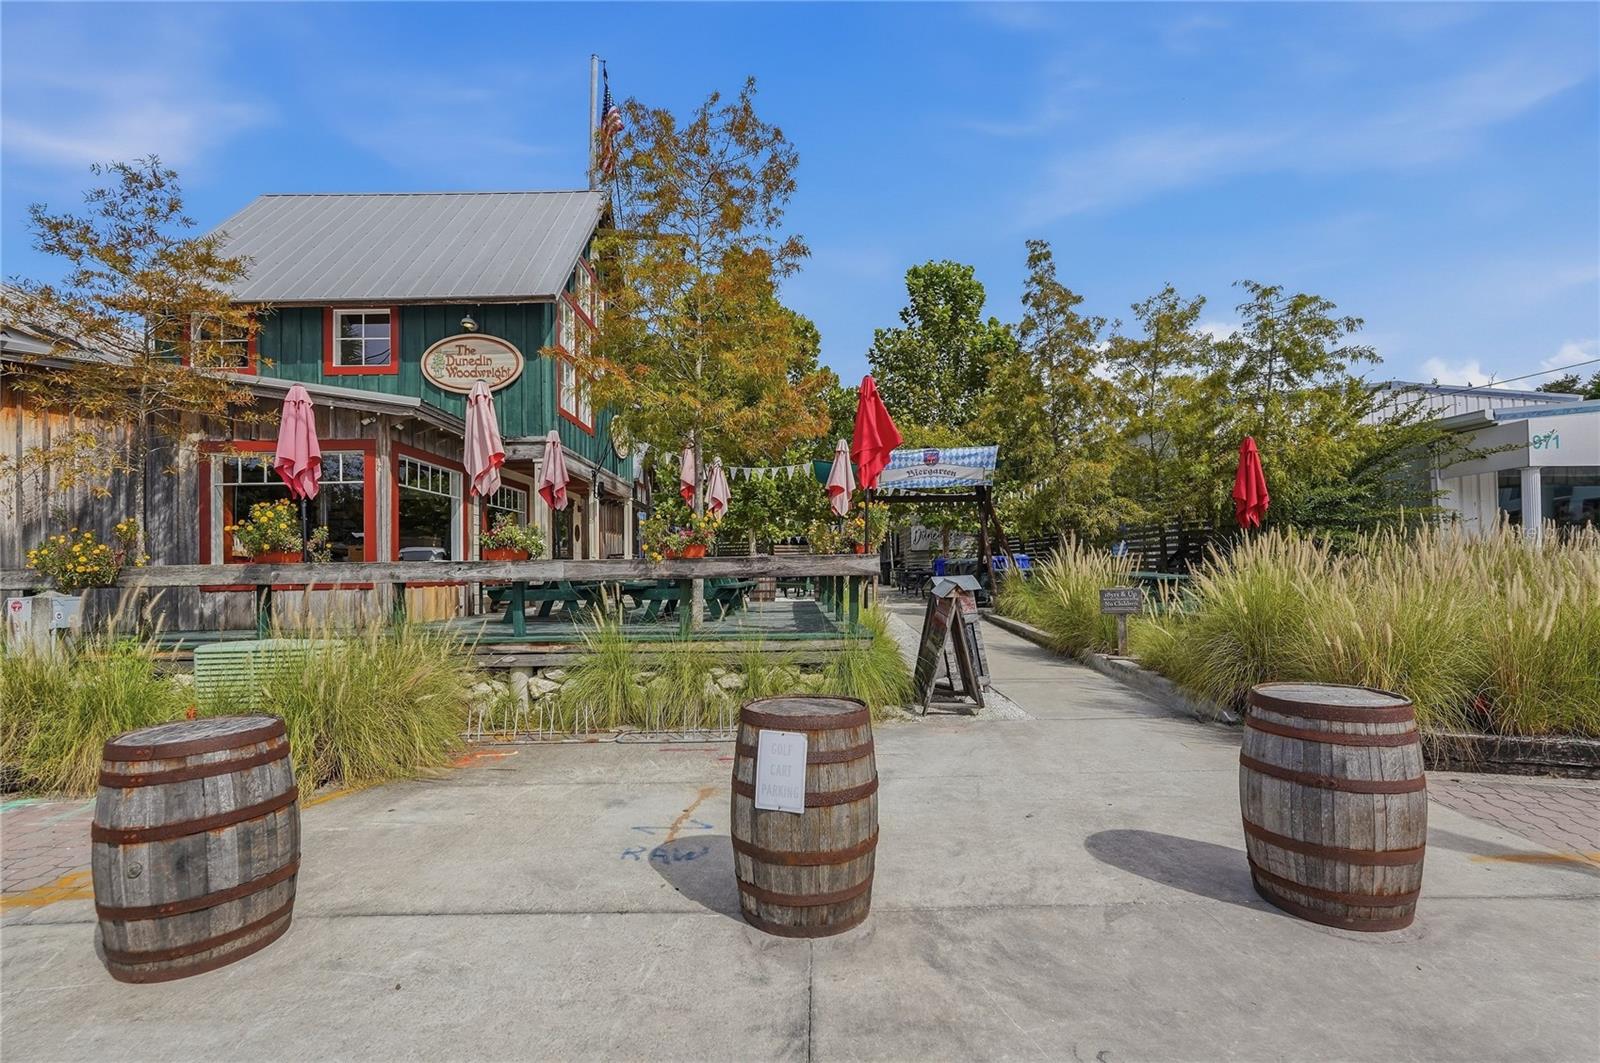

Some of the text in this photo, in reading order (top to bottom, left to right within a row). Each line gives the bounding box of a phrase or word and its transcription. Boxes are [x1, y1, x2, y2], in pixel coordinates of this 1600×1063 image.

[455, 344, 477, 356] The
[445, 354, 493, 367] Dunedin
[445, 365, 511, 384] Woodwright
[1532, 434, 1560, 450] 971
[906, 467, 957, 478] Biergarten
[1127, 590, 1138, 599] Up
[771, 743, 792, 756] GOLF
[770, 764, 792, 777] CART
[761, 783, 800, 799] PARKING
